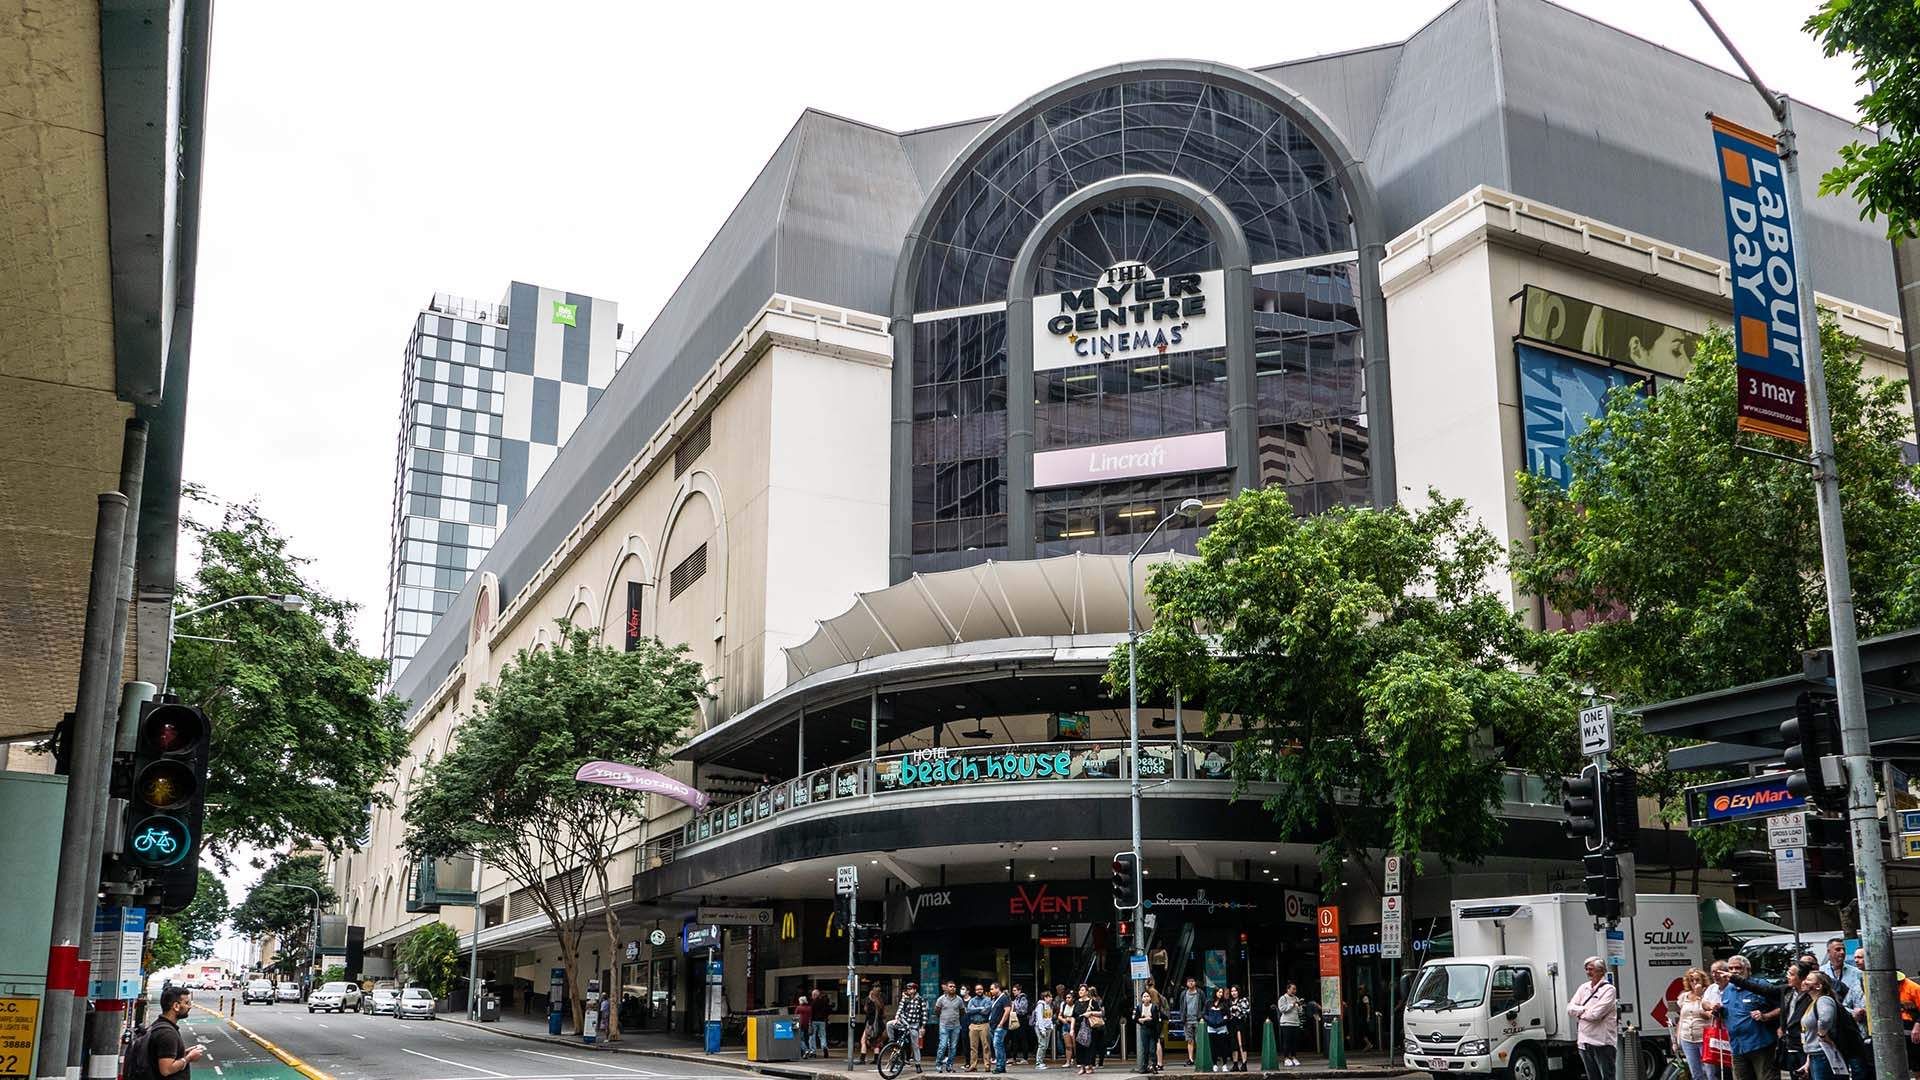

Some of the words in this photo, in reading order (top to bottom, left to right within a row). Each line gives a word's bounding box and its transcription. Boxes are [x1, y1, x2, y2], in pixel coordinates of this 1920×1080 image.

[1104, 263, 1147, 284] THE
[1061, 274, 1202, 312] MYER
[1047, 296, 1206, 335] CENTRE
[1074, 325, 1183, 357] CINEMAS
[1749, 378, 1757, 395] 3
[1088, 443, 1166, 473] Lincraft
[1584, 710, 1604, 724] ONE
[1583, 723, 1605, 738] WAY
[913, 746, 951, 762] HOTEL
[903, 755, 980, 785] beach
[987, 752, 1071, 779] house
[839, 875, 852, 883] WAY
[840, 868, 852, 876] ONE
[906, 891, 951, 927] Vmax
[1010, 885, 1089, 914] EVENT
[1644, 932, 1690, 945] SCULLY
[1342, 943, 1382, 956] STARBU
